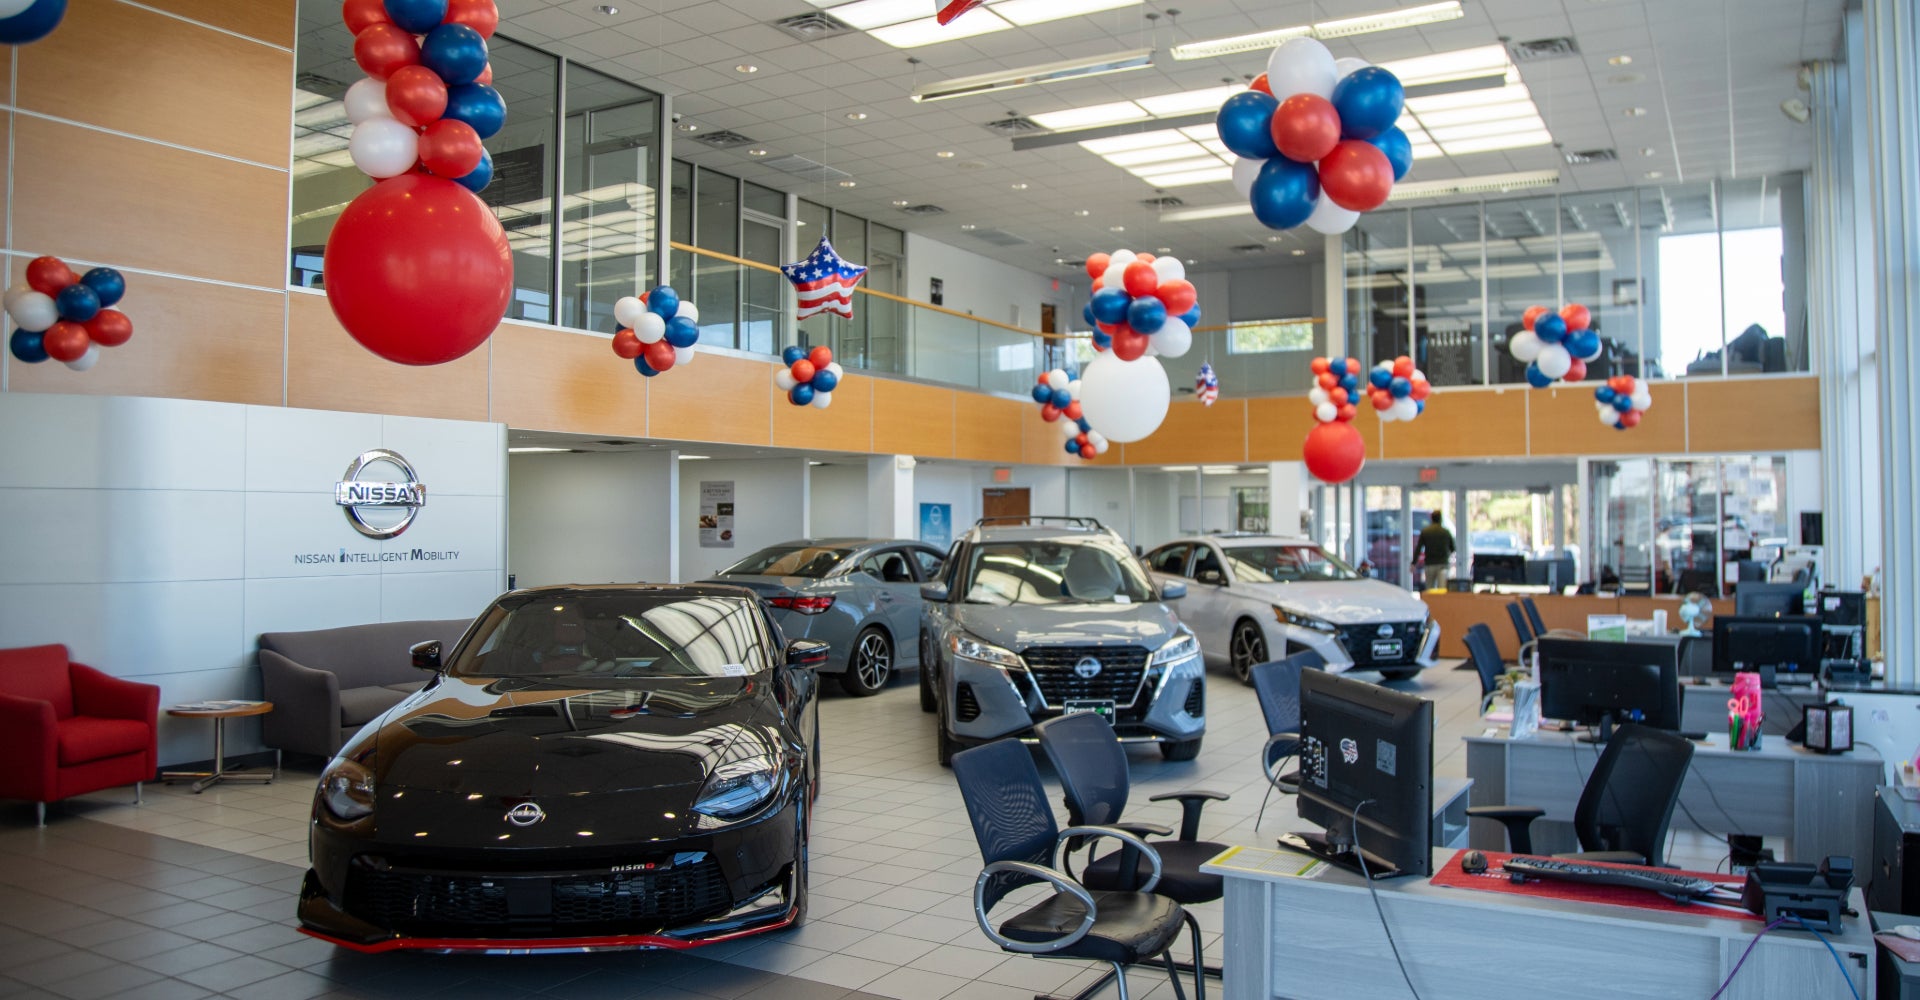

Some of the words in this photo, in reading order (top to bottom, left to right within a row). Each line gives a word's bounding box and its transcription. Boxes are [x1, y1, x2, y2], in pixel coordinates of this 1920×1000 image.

[348, 486, 421, 501] NISSAN
[1243, 517, 1270, 531] EN
[294, 553, 336, 565] NISSAN
[339, 548, 408, 563] INTELLIGENT
[410, 549, 460, 561] MOBILITY
[611, 862, 655, 872] nismo
